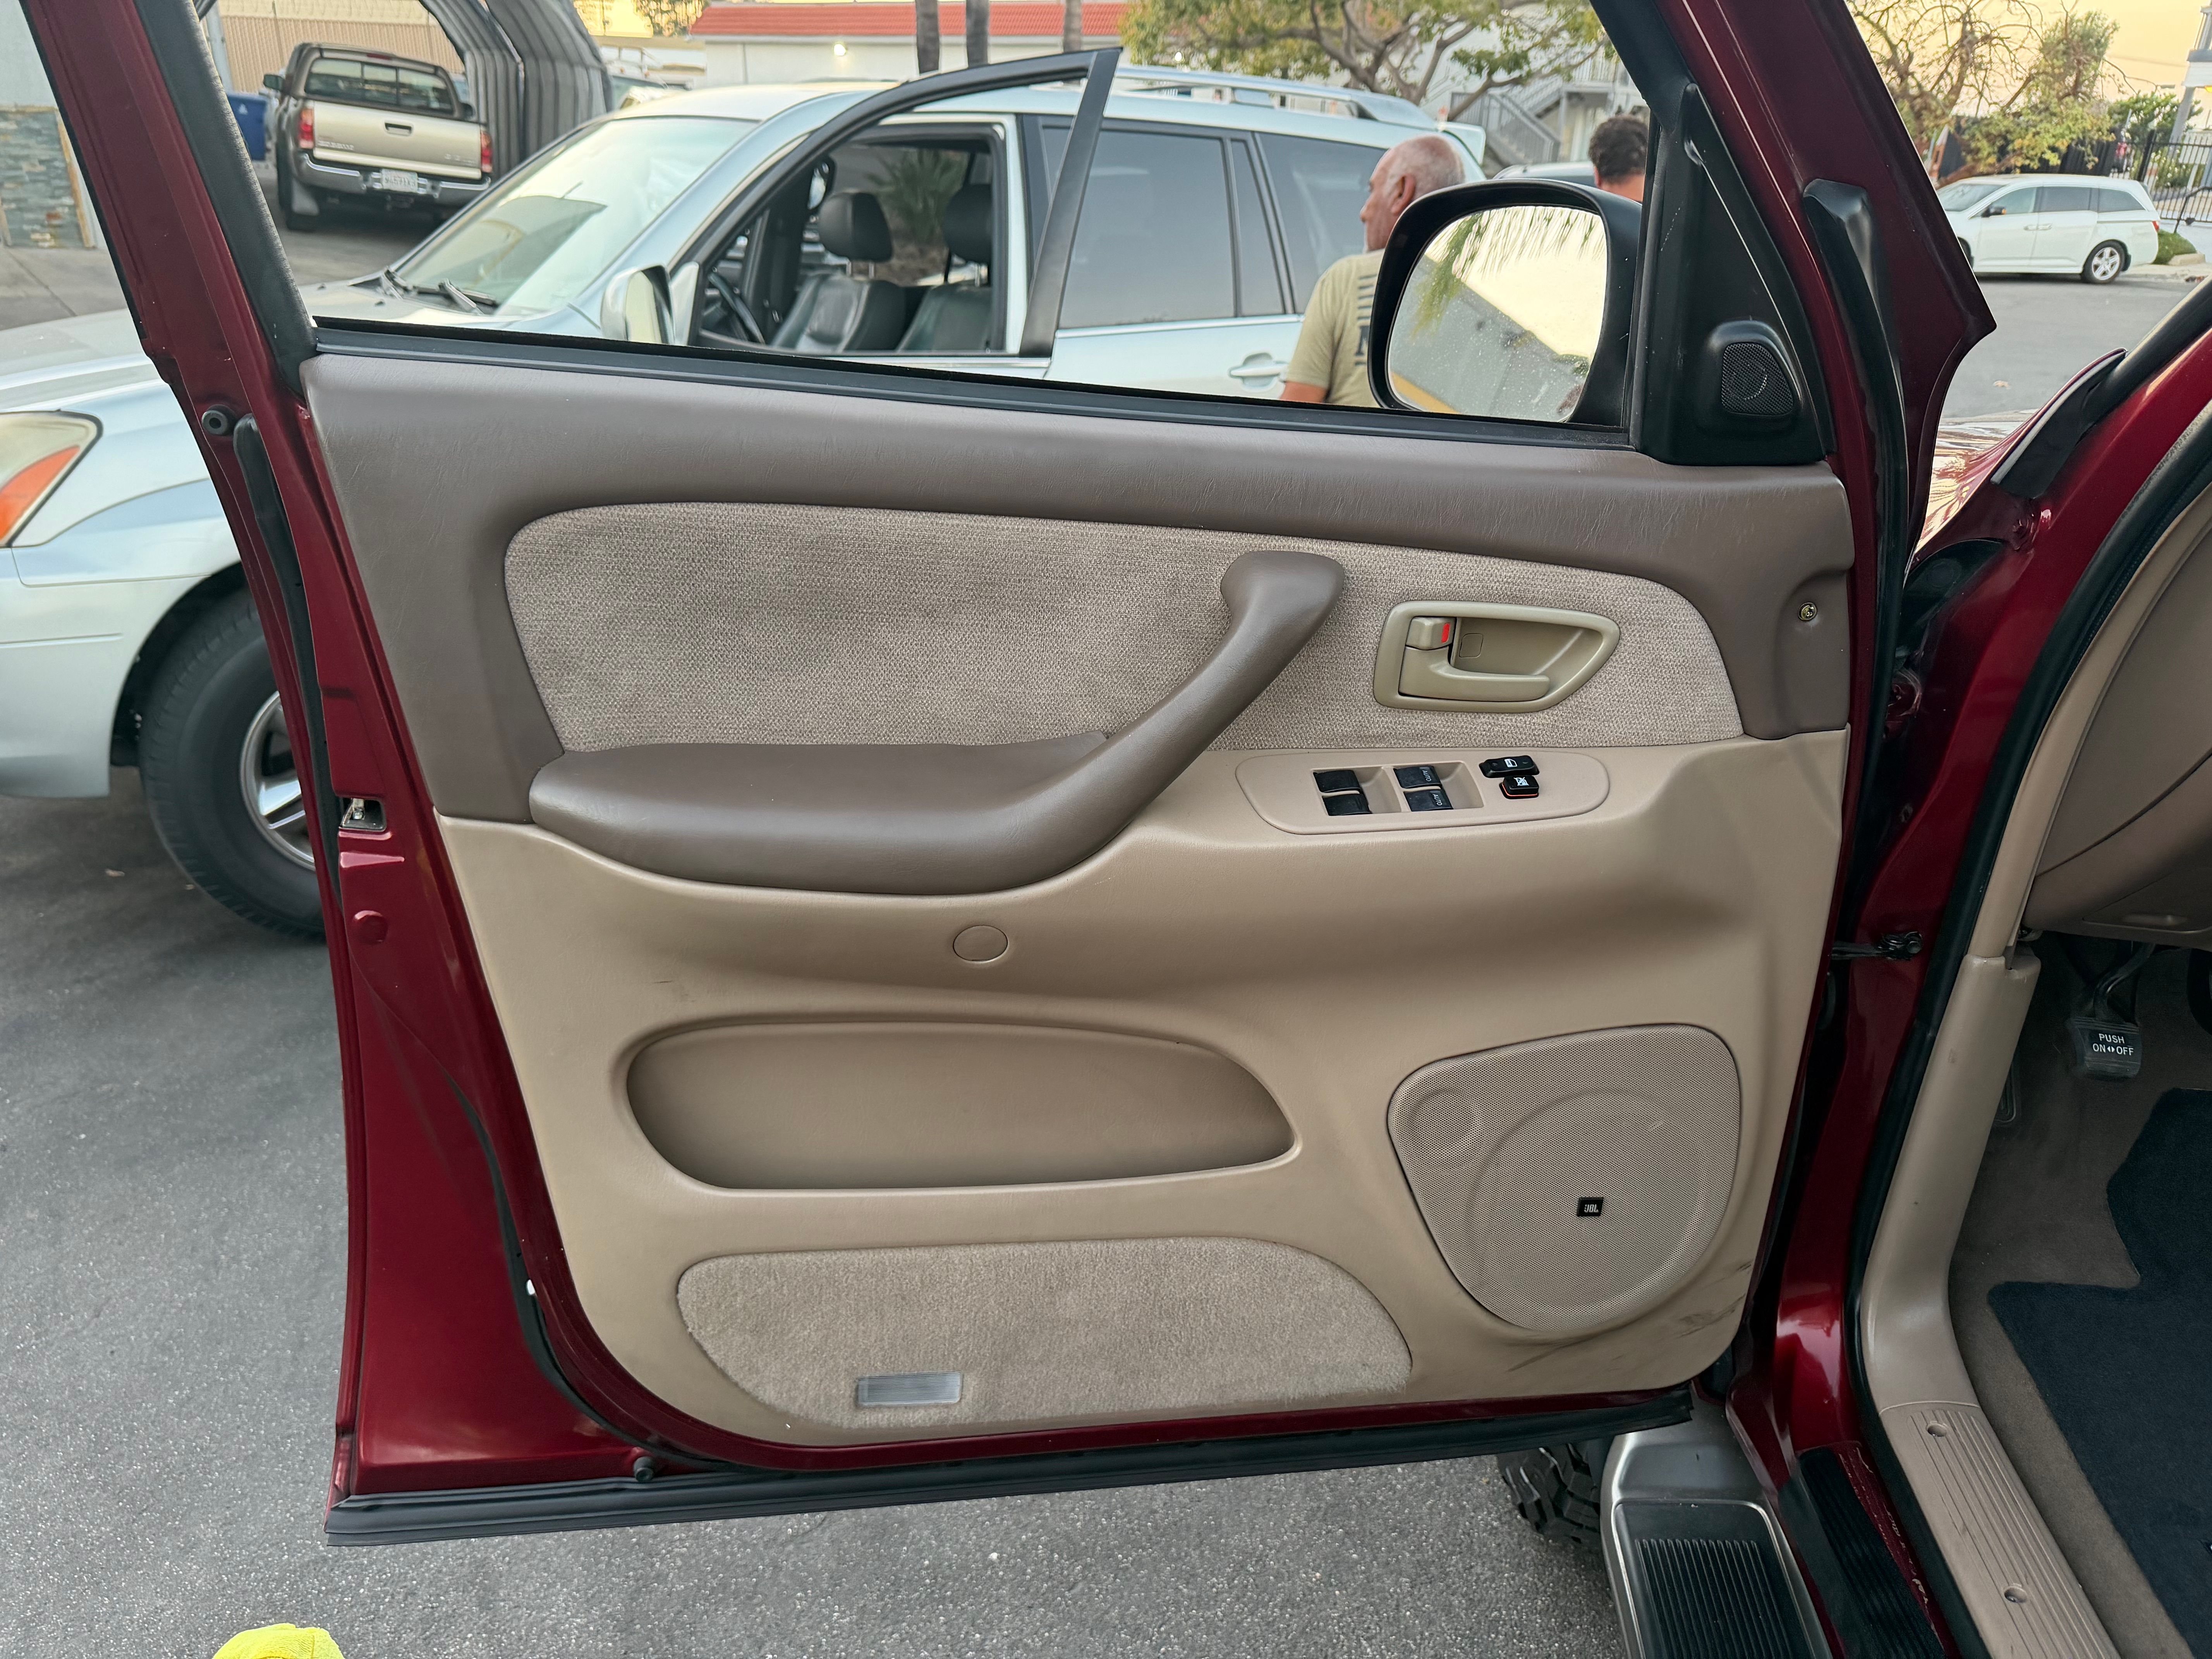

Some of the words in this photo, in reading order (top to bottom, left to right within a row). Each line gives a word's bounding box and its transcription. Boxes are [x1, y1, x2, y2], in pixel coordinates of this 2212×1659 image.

[1422, 770, 1432, 781] AUTO
[1432, 794, 1443, 806] AUTO
[2099, 1033, 2125, 1044] PUSH
[2092, 1043, 2106, 1053] ON
[2116, 1046, 2134, 1056] OFF
[1584, 1204, 1599, 1213] JBL
